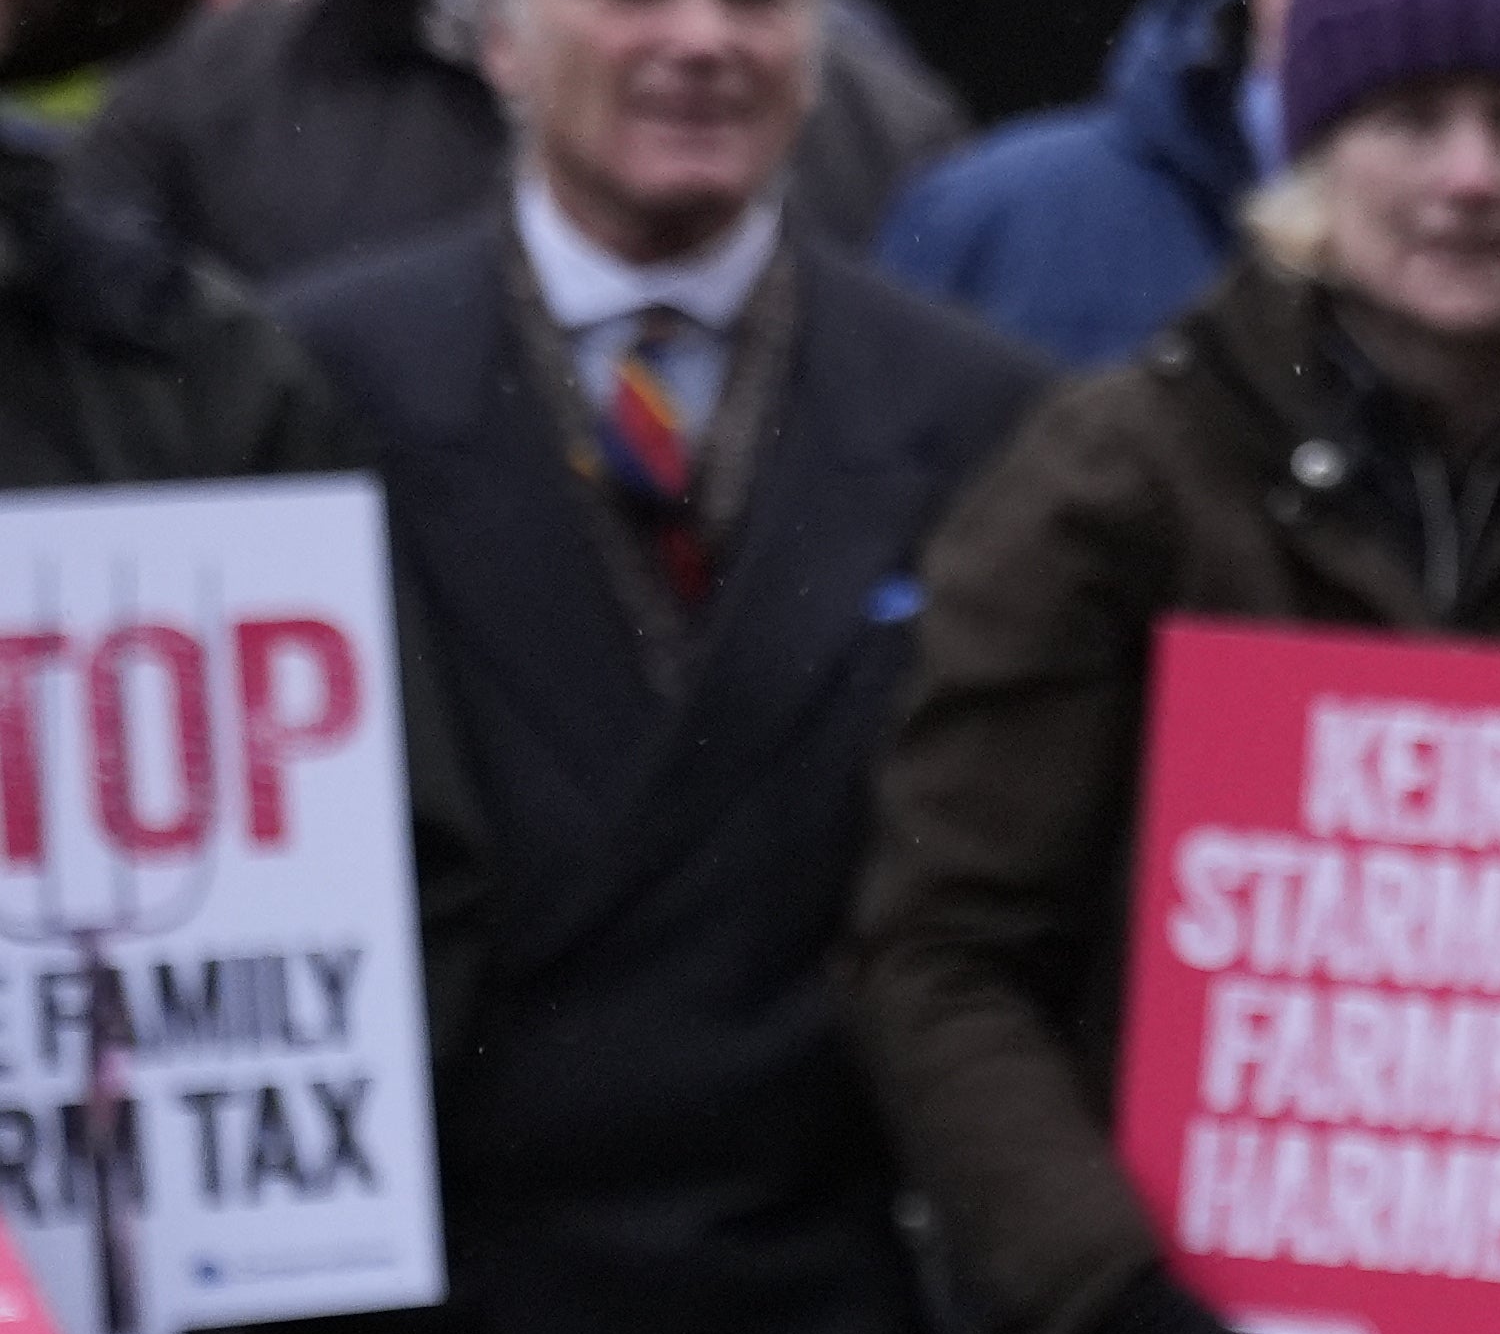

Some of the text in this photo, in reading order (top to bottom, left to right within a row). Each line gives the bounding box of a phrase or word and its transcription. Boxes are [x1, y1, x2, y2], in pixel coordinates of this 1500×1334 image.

[0, 613, 364, 869] TOP
[37, 942, 366, 1069] FAMILY
[0, 1073, 384, 1227] RM TAX
